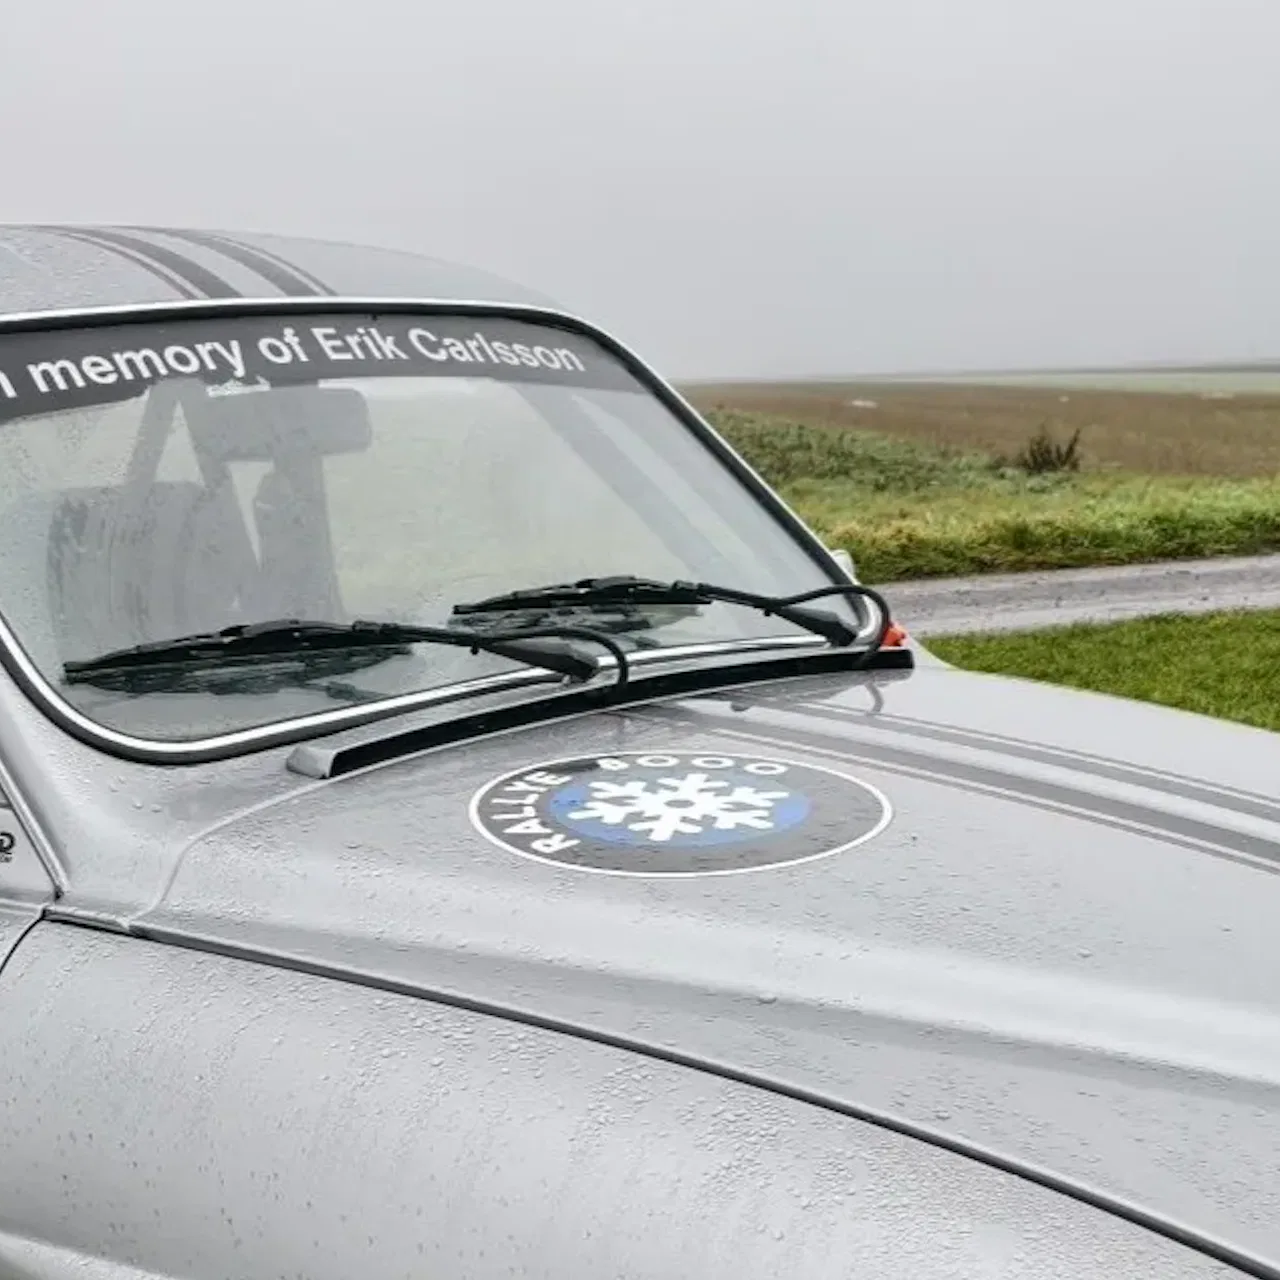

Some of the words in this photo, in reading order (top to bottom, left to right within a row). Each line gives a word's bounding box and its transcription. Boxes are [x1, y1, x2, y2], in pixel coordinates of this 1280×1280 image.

[25, 334, 247, 394] memory
[258, 325, 308, 365] of
[312, 326, 407, 363] Erik
[411, 328, 586, 373] Carlsson
[489, 770, 582, 855] RALLYE
[596, 754, 789, 775] 8000
